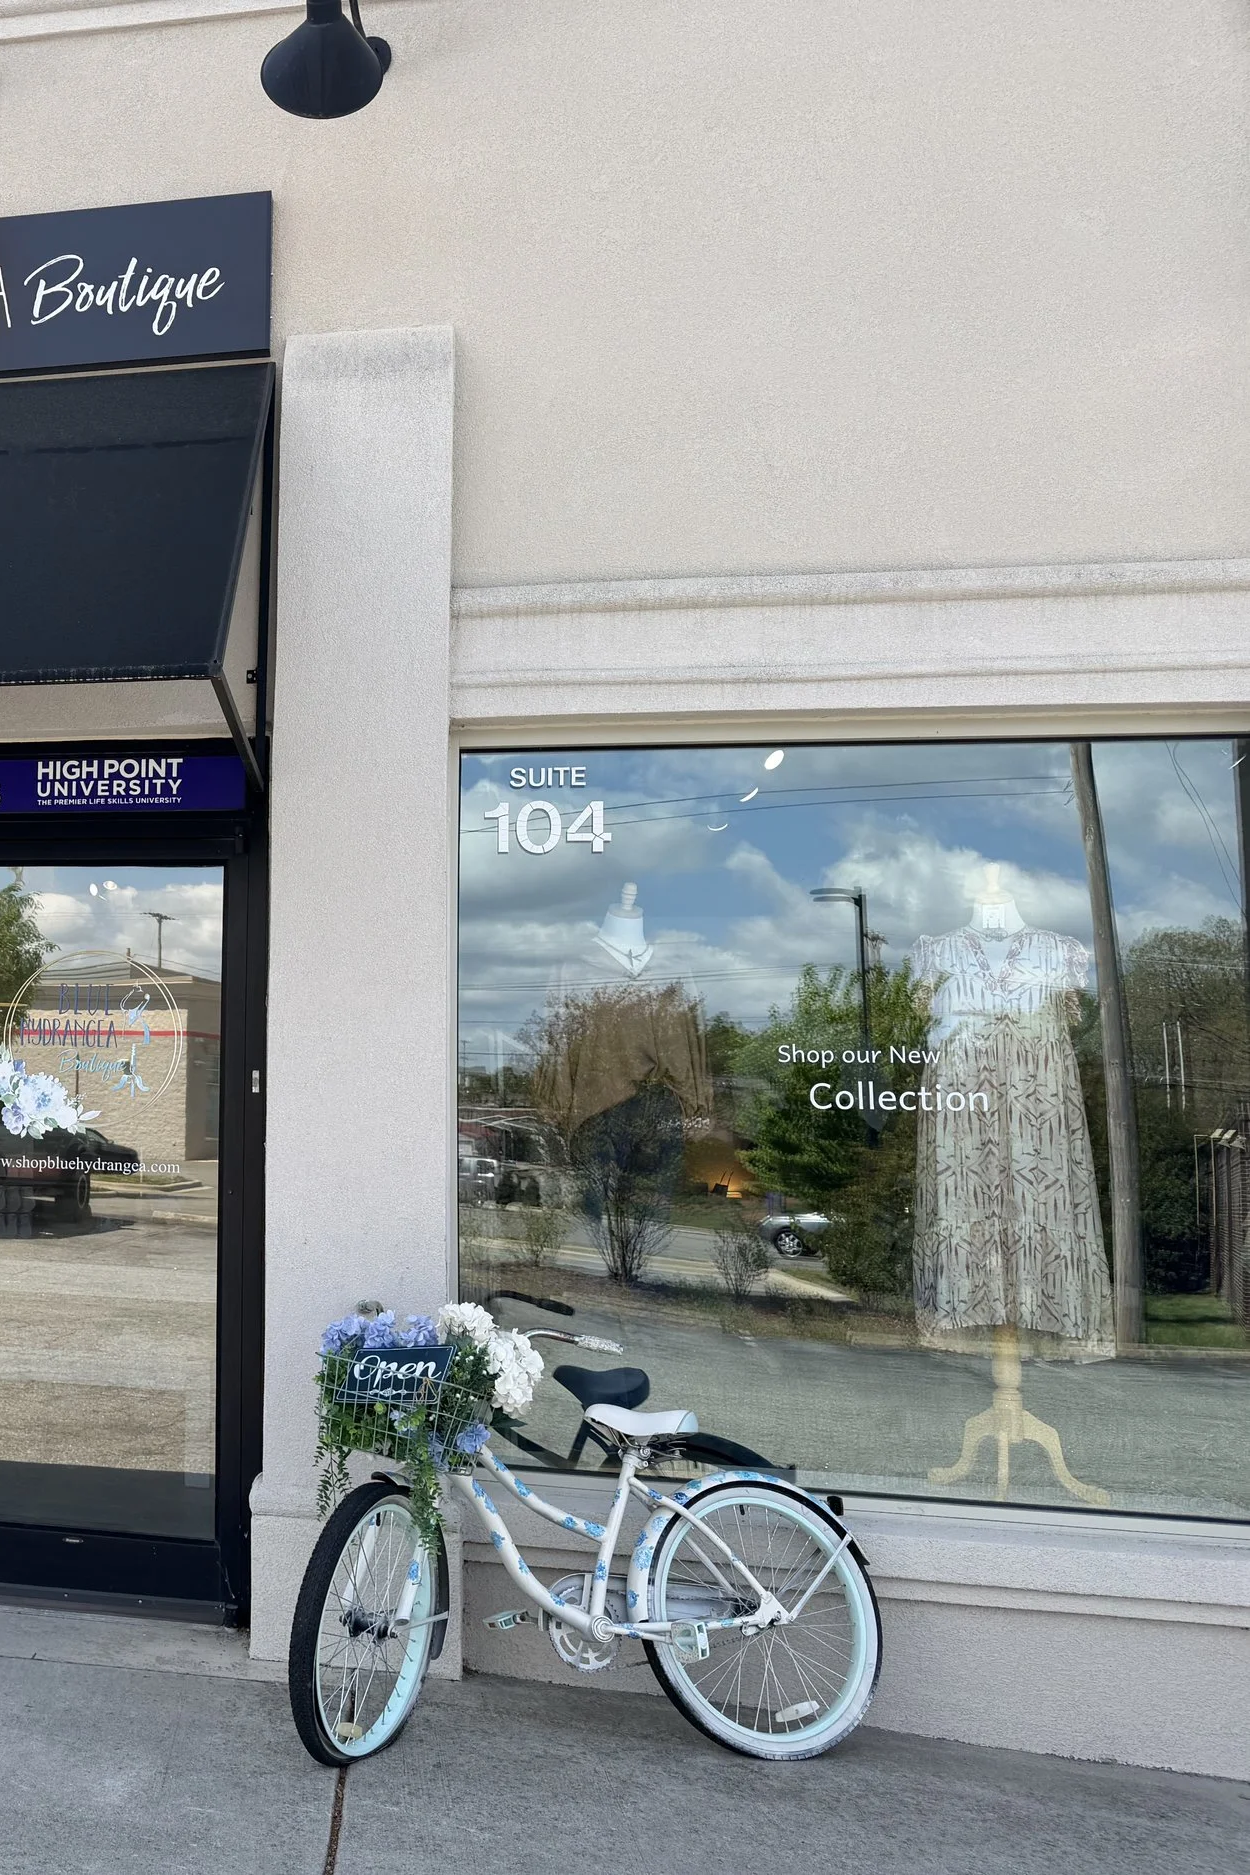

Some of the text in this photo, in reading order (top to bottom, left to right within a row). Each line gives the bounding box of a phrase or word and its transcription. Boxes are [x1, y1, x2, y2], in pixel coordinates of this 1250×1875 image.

[23, 254, 226, 336] Boutique
[37, 758, 184, 780] HIGH POINT
[509, 766, 587, 789] SUITE
[37, 779, 183, 797] UNIVERSITY
[54, 798, 87, 806] PREMIER
[107, 797, 134, 805] SKILLS
[135, 796, 182, 804] UNIVERSITY
[484, 800, 612, 855] 104
[58, 983, 114, 1016] BLUE
[19, 1015, 118, 1049] HYDRANGEA
[58, 1048, 127, 1082] Boutique
[777, 1044, 941, 1068] Shop our New
[809, 1081, 989, 1112] Collection
[353, 1354, 442, 1388] Open
